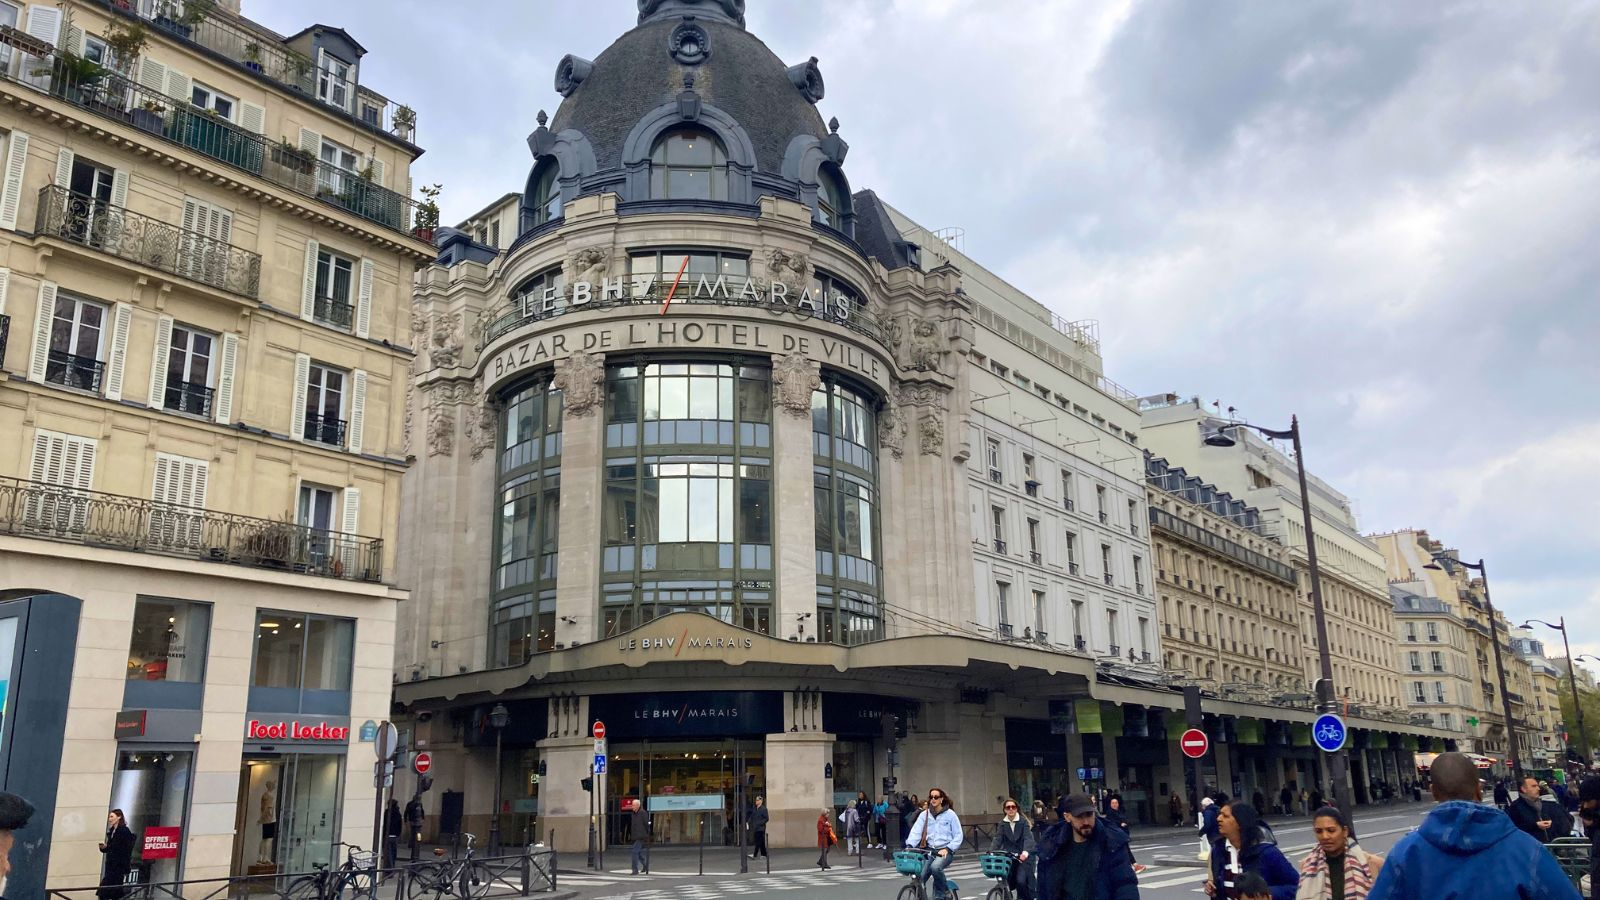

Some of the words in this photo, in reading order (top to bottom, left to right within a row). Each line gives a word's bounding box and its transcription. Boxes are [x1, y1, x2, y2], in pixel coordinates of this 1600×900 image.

[522, 287, 556, 318] LE
[495, 334, 570, 379] BAZAR
[583, 330, 612, 350] DE
[629, 322, 768, 348] L'HOTEL
[783, 334, 809, 355] DE
[820, 338, 879, 381] VILLE
[619, 639, 636, 651] LE
[634, 710, 648, 719] LE
[248, 720, 287, 740] Foot
[291, 721, 348, 740] Locker
